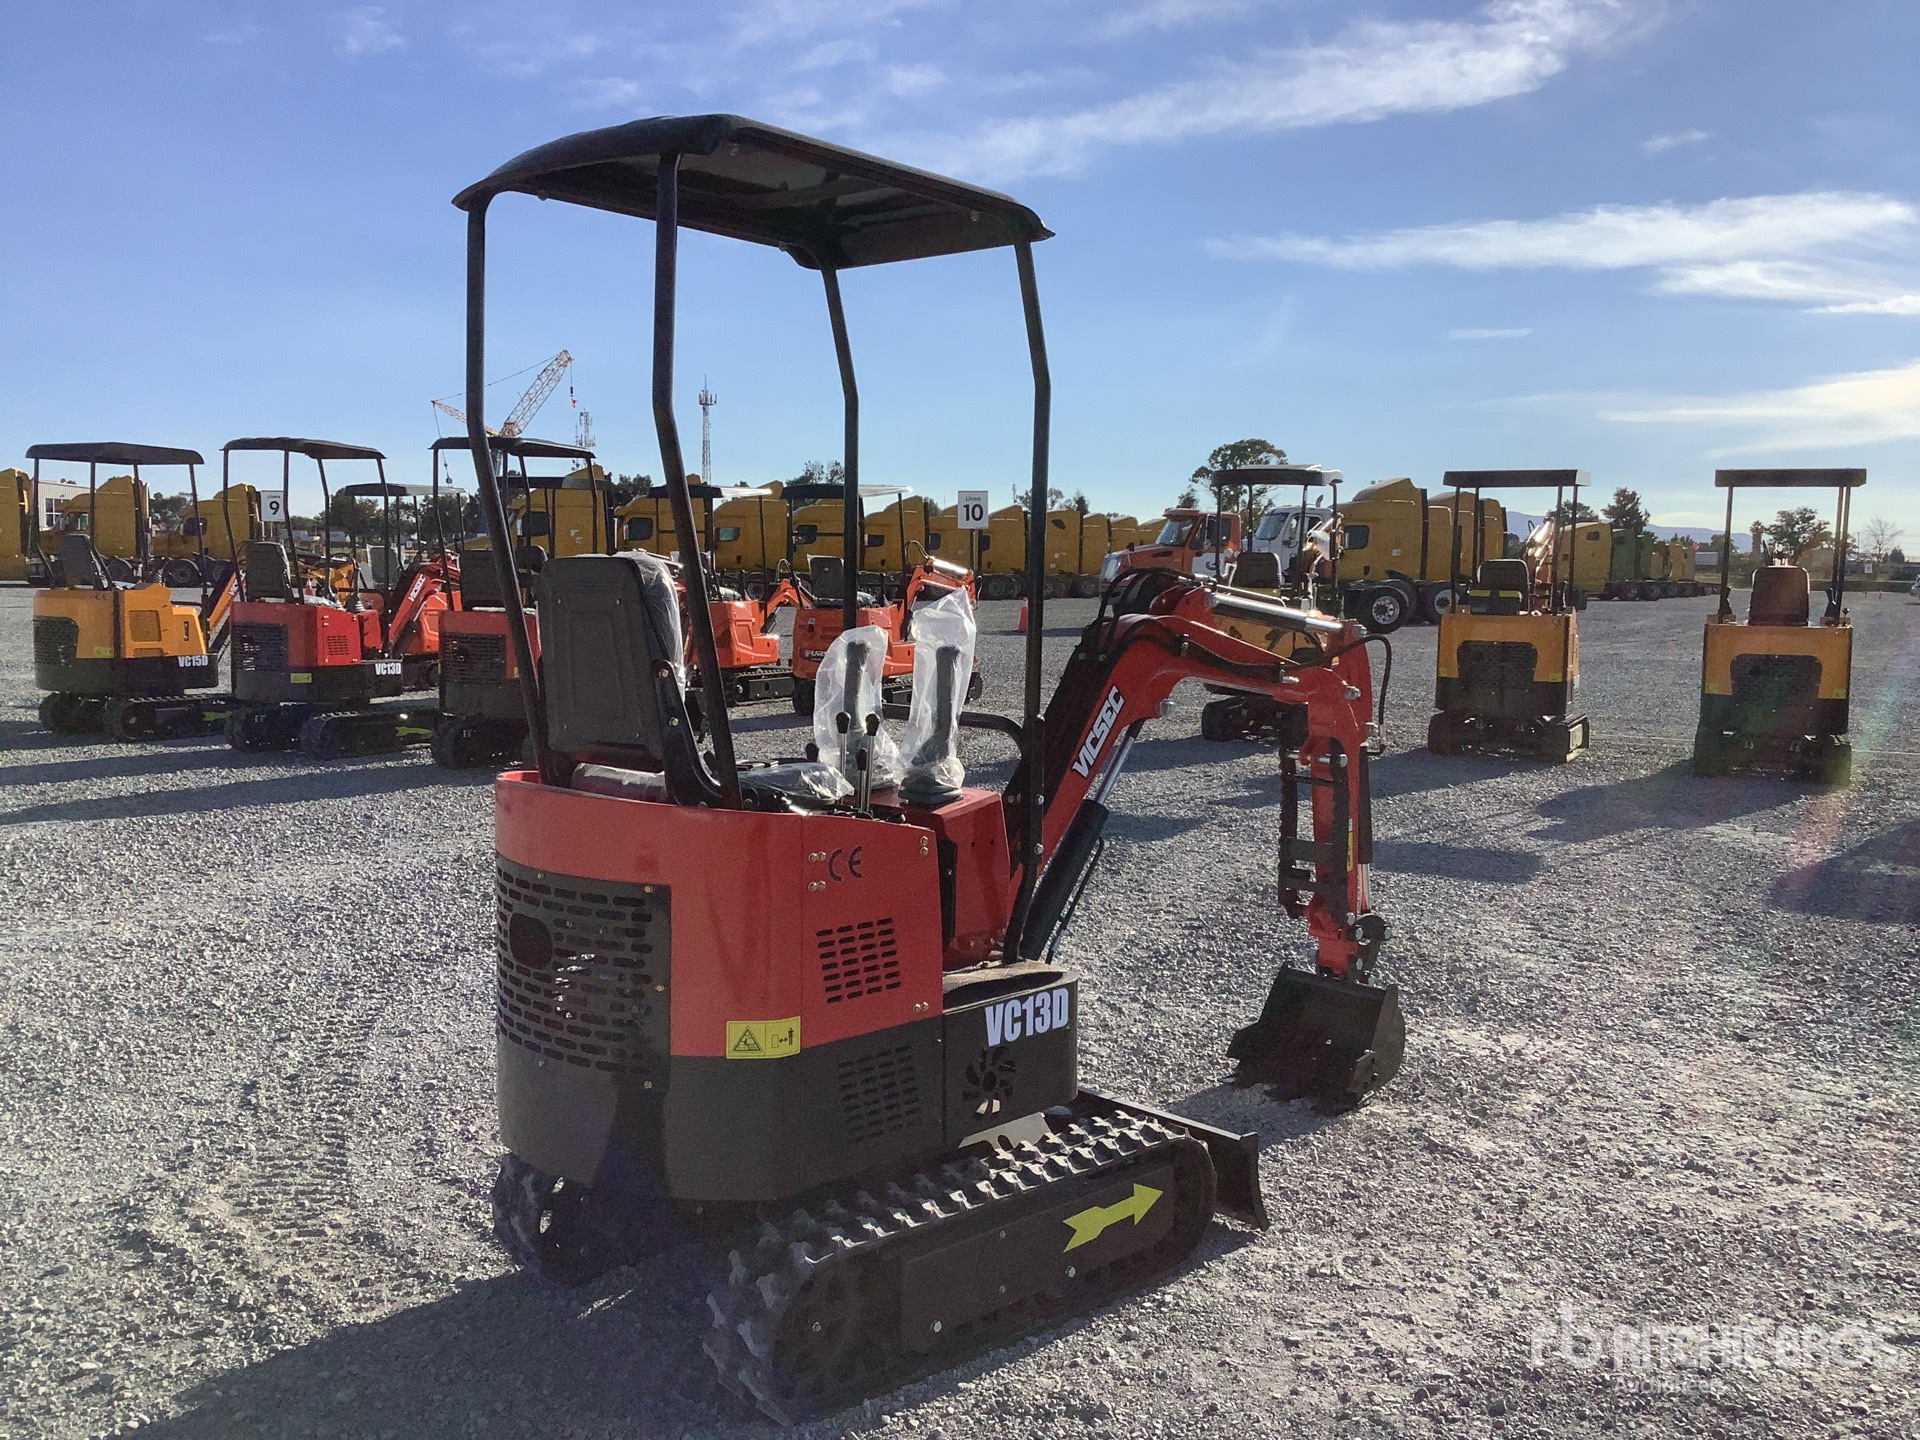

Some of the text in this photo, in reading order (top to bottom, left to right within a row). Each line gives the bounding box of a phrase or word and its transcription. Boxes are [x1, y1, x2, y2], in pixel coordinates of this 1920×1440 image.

[269, 501, 280, 515] 9
[963, 503, 984, 522] 10
[408, 573, 426, 602] VICSEC
[178, 654, 209, 667] VC15D
[375, 662, 402, 675] VC13D
[1072, 685, 1125, 778] VICSEC
[828, 845, 863, 882] CE
[984, 987, 1069, 1047] VC13D
